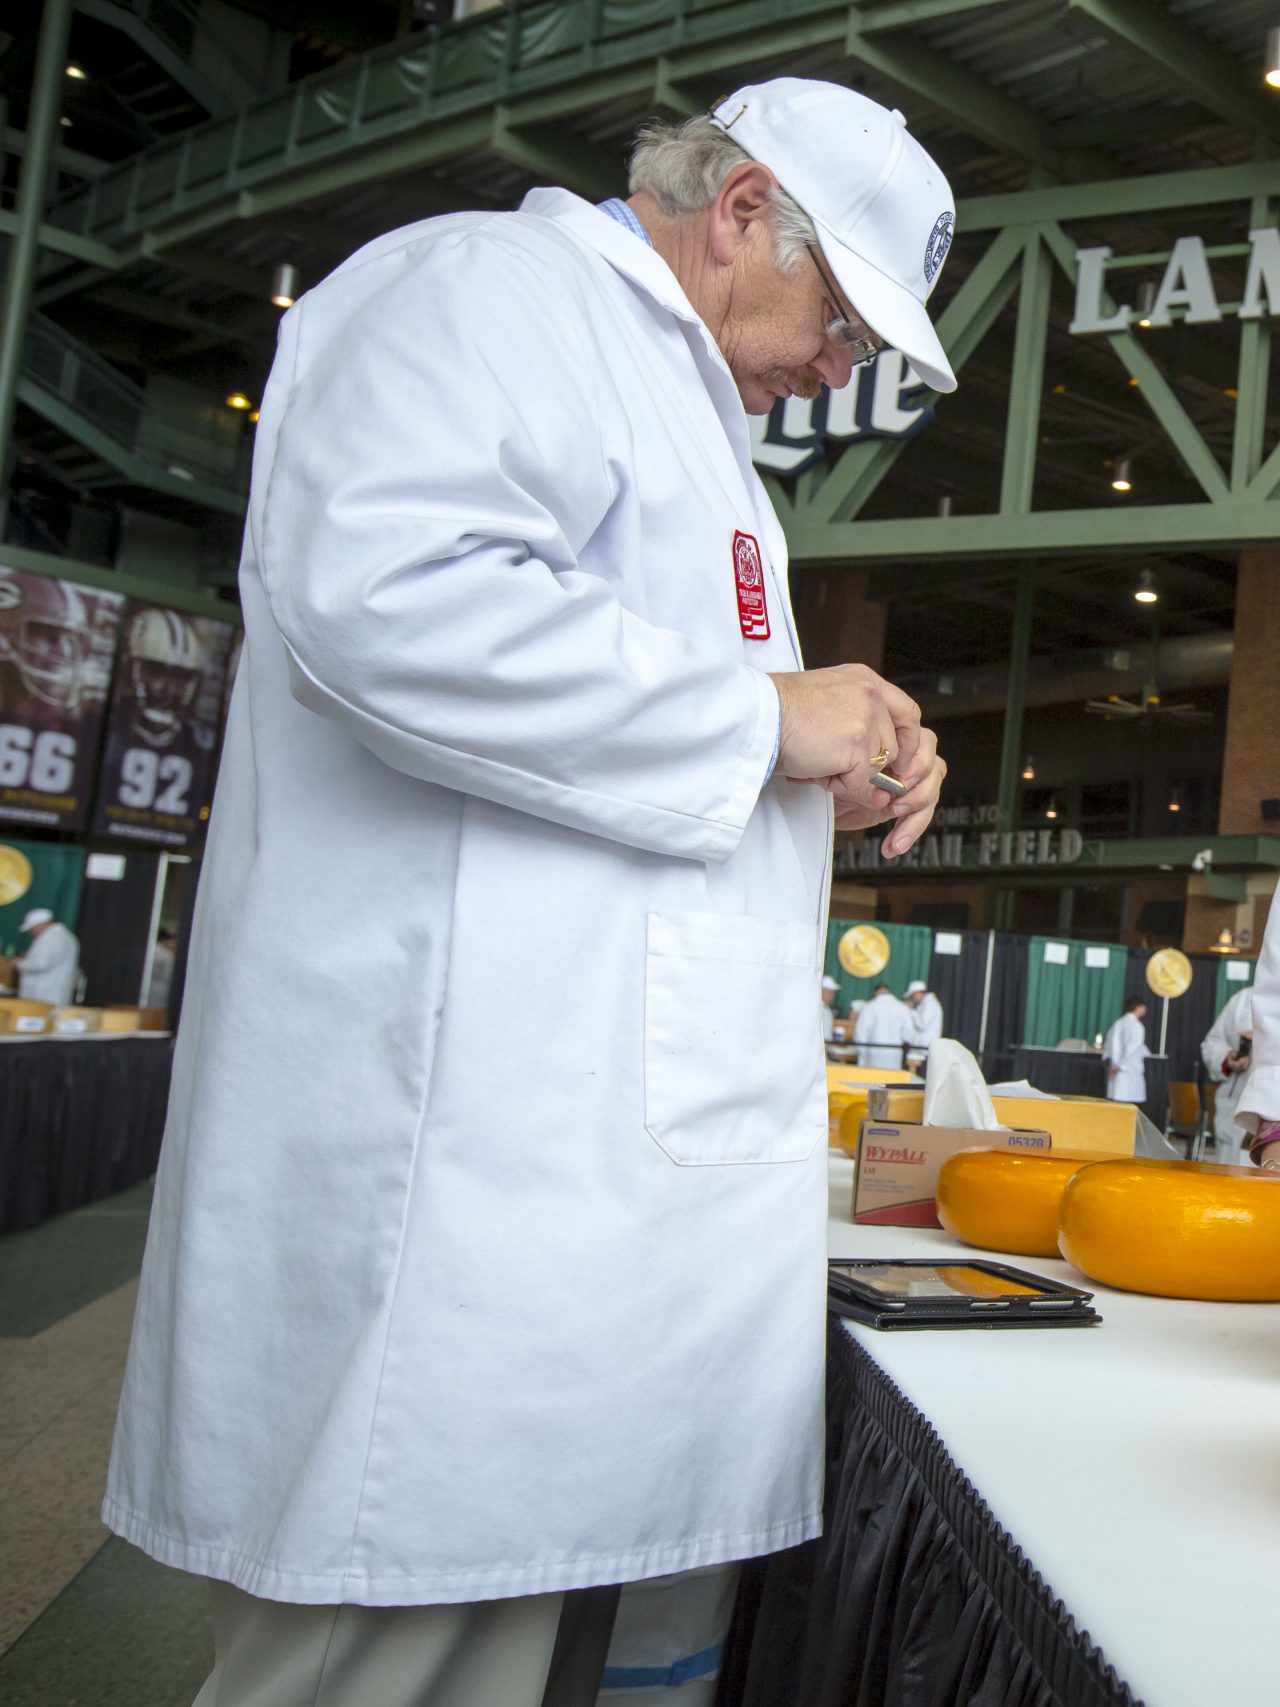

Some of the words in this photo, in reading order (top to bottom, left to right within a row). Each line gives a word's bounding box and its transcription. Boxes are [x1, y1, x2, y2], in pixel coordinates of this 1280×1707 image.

[0, 724, 77, 793] 66
[118, 747, 194, 816] 92
[977, 828, 1084, 866] FIELD
